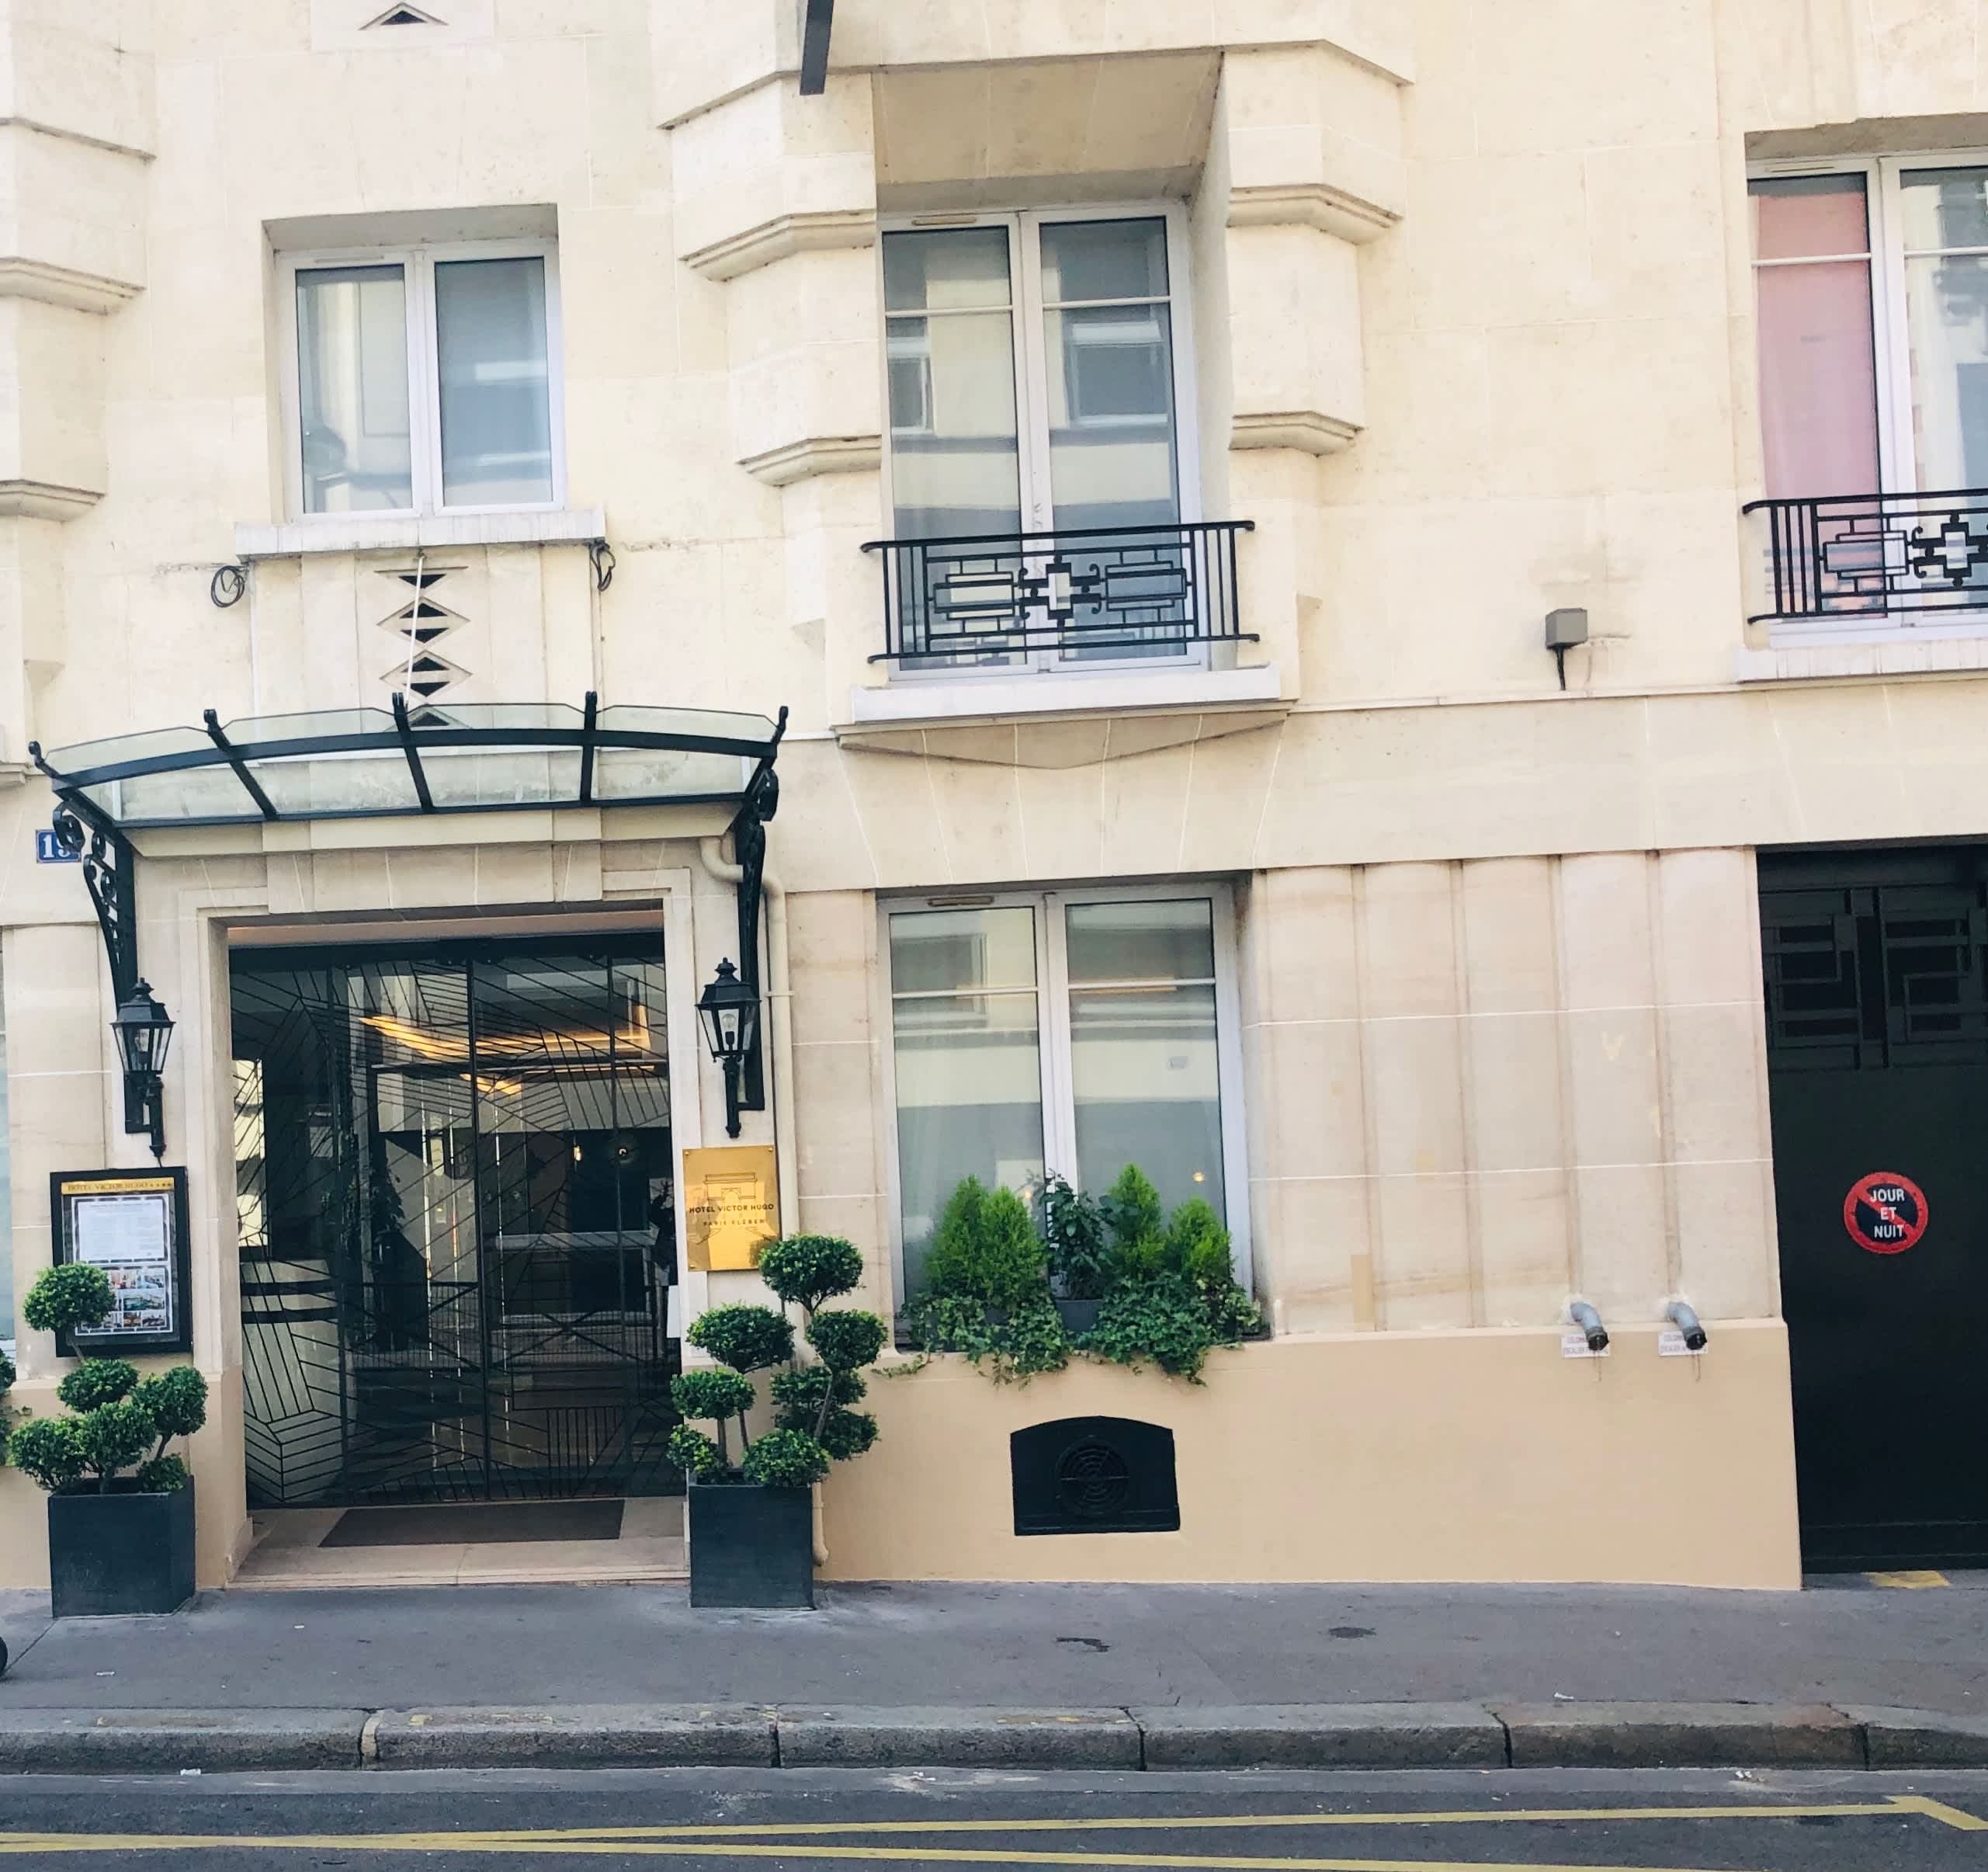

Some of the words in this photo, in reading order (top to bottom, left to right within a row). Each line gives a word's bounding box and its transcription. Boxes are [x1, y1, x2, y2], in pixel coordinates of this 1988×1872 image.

[1869, 1188, 1905, 1203] JOUR
[1879, 1206, 1897, 1221] ET
[1873, 1224, 1905, 1238] NUIT
